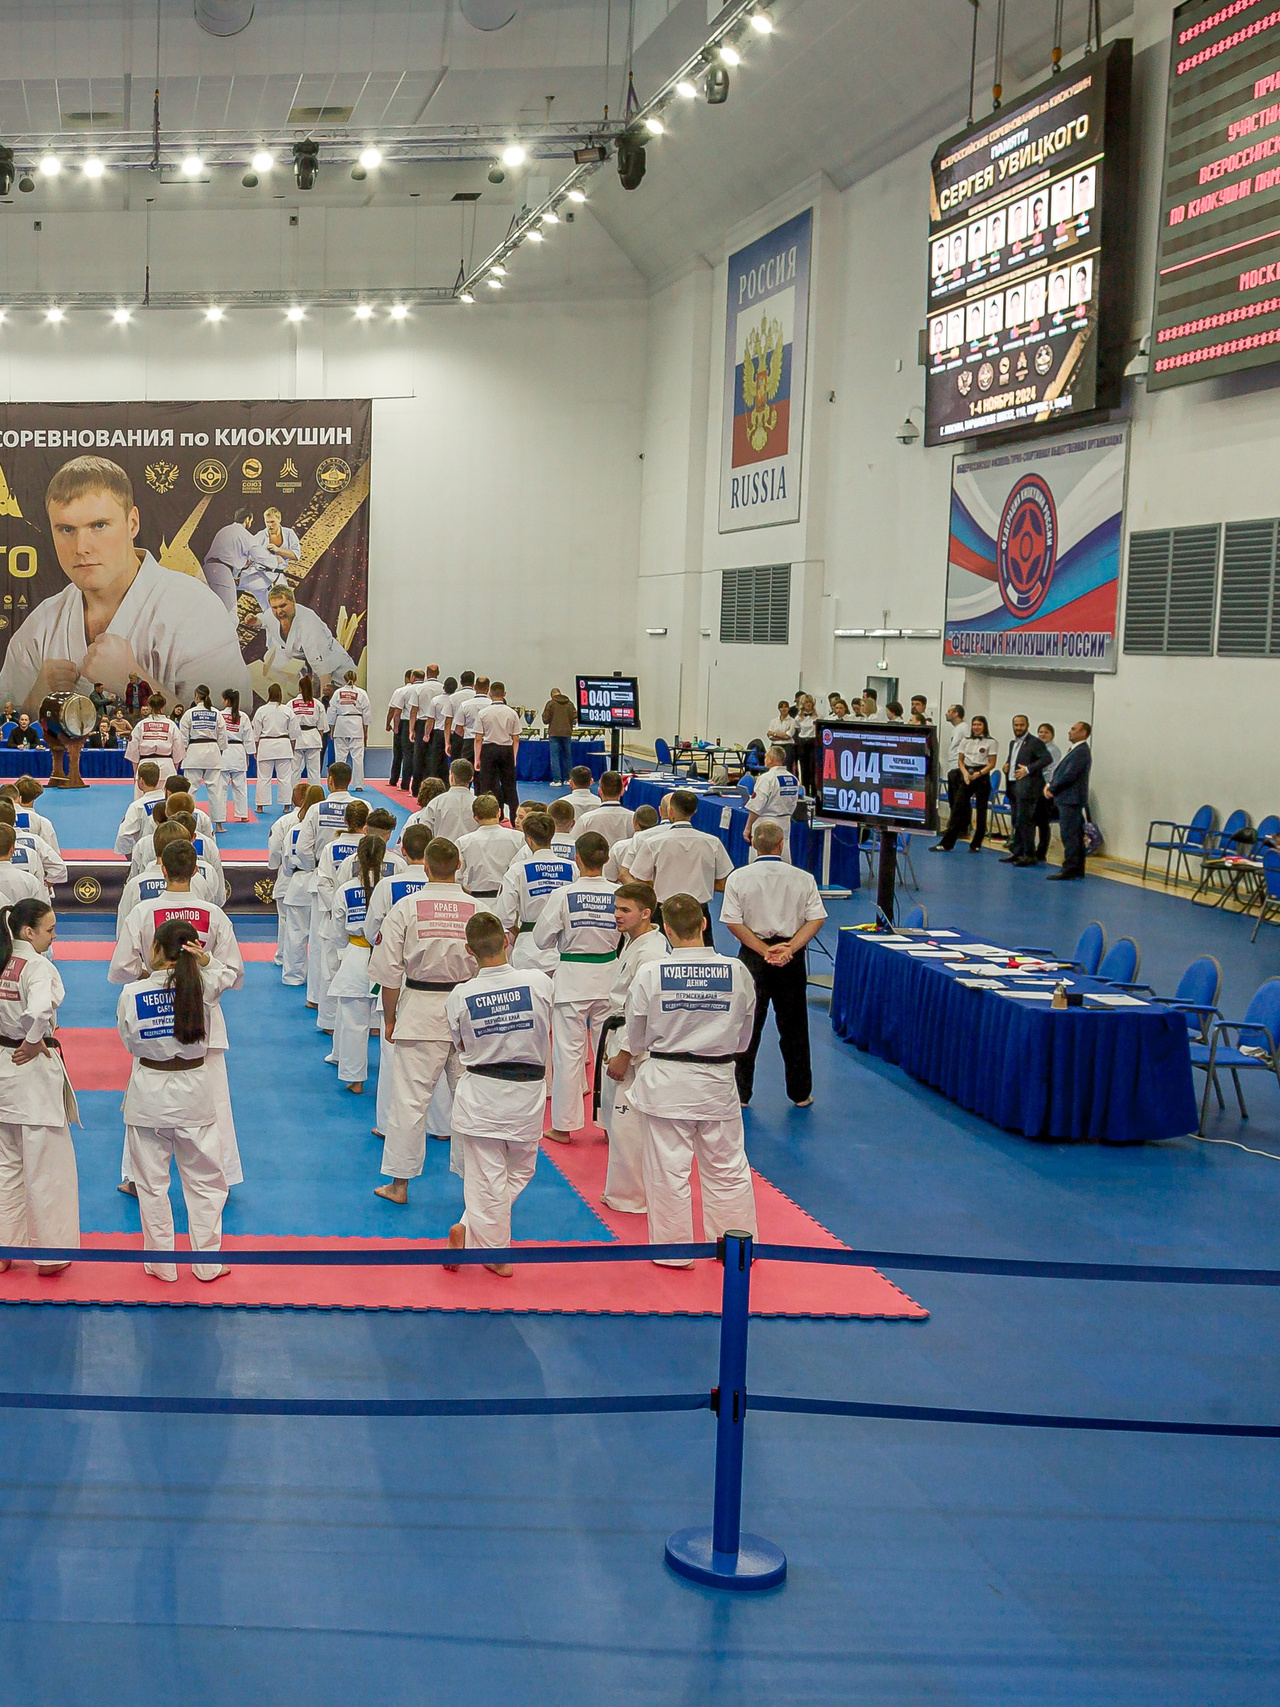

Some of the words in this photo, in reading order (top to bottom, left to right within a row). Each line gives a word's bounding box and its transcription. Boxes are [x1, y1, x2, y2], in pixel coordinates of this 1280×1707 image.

[990, 127, 1029, 160] ПАМЯТИ
[939, 163, 995, 212] СЕРГЕЯ
[998, 113, 1090, 181] УВИЦКОГО
[738, 246, 797, 304] РОССИЯ
[1015, 385, 1036, 404] 2024
[180, 432, 210, 447] по
[215, 426, 352, 446] КИОКУШИН
[730, 466, 787, 510] RUSSIA
[1005, 632, 1059, 657] КИОКУШИН
[589, 690, 610, 707] 040
[589, 709, 611, 722] 03:00
[823, 749, 837, 779] А
[840, 750, 880, 784] 044
[838, 788, 880, 814] 02:00
[165, 910, 200, 921] ЗАРИПОВ
[434, 903, 458, 912] КРАЕВ
[664, 966, 729, 979] КУДЕЛЕНСКИЙ
[686, 979, 708, 987] ДЕНИС
[475, 990, 521, 1008] СТАРИКОВ
[491, 1004, 510, 1014] ДАНИЛ
